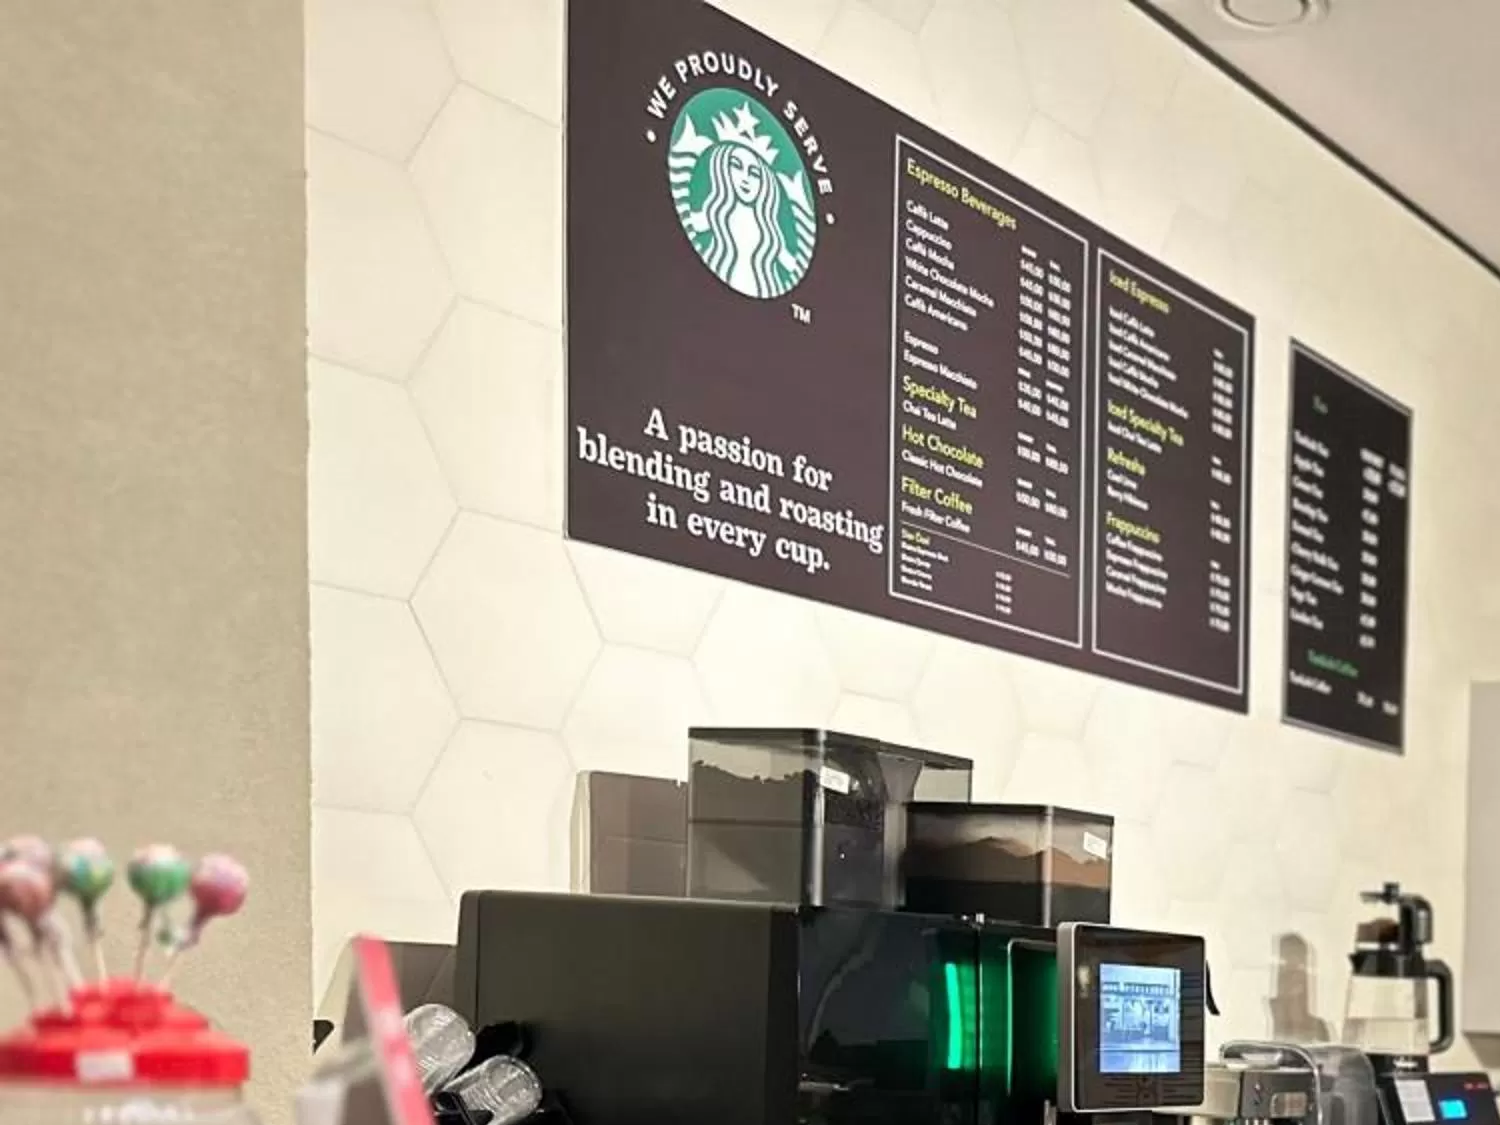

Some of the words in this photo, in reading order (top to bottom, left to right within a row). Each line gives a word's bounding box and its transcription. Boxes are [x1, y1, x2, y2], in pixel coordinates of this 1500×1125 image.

[647, 76, 677, 119] WE
[674, 51, 779, 98] PROUDLY
[784, 100, 832, 194] SERVE
[906, 157, 959, 199] Espresso
[961, 187, 1018, 231] Beverages
[902, 375, 955, 413] Specialty
[957, 396, 977, 419] Tea
[644, 407, 669, 440] A
[678, 424, 785, 477] passion
[792, 454, 833, 492] for
[902, 424, 924, 447] Hot
[927, 433, 984, 469] Chocolate
[576, 426, 711, 503] blending
[719, 477, 772, 514] and
[779, 496, 885, 554] roasting
[901, 475, 932, 501] Filter
[934, 487, 974, 515] Coffee
[646, 493, 678, 530] in
[687, 511, 767, 557] every
[775, 536, 831, 574] cup.
